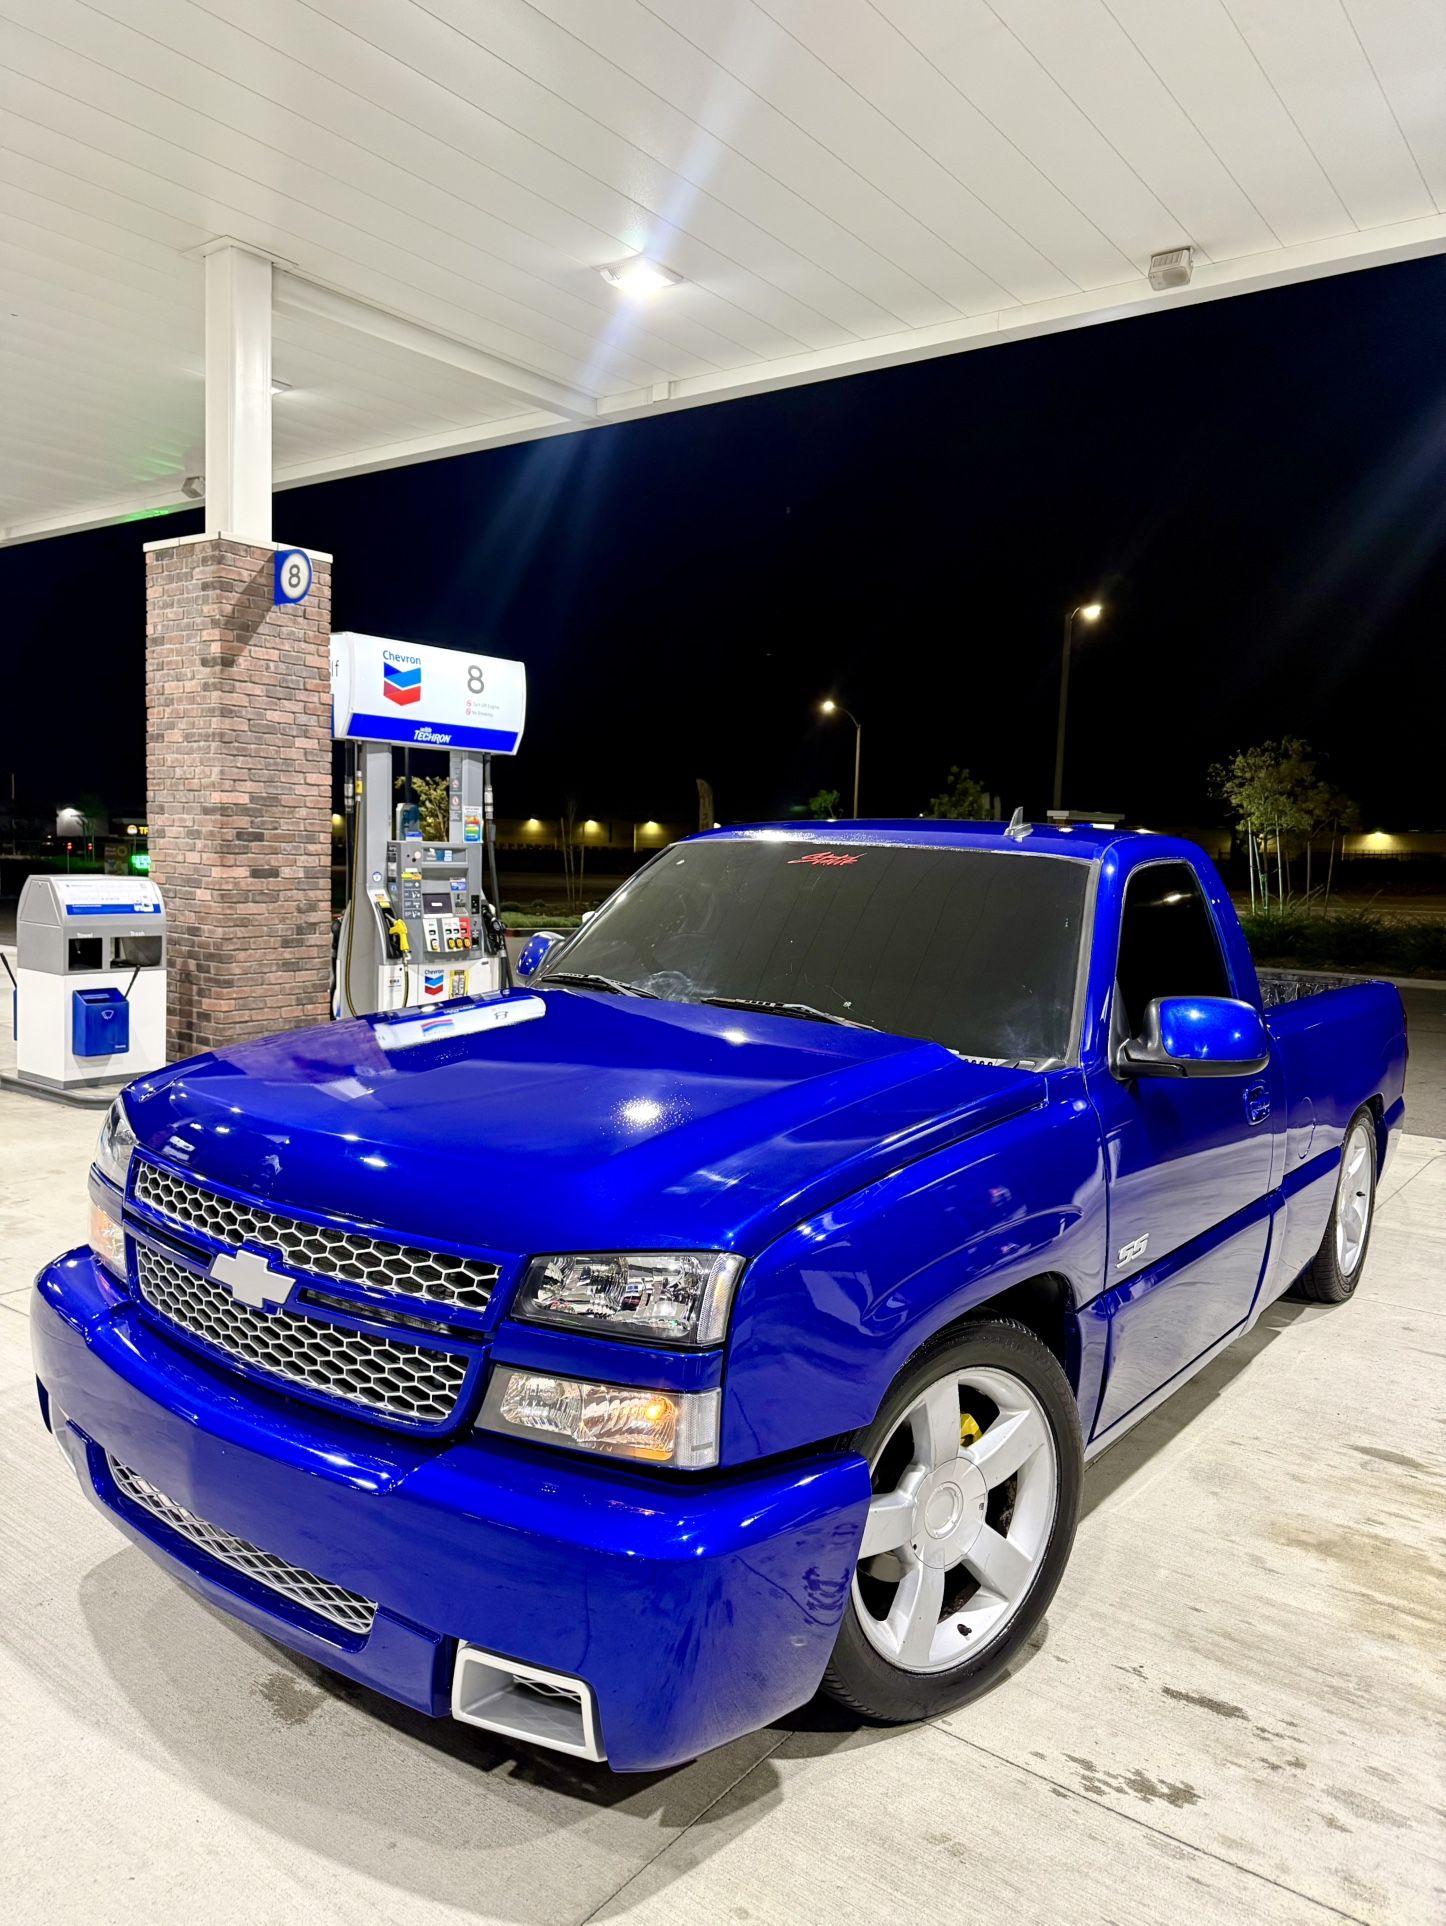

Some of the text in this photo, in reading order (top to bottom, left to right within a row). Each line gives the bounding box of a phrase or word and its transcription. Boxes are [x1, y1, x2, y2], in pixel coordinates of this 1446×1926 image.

[288, 564, 301, 589] 8
[382, 649, 422, 665] Chevron
[467, 664, 485, 694] 8
[413, 729, 452, 744] TECHRON
[1115, 1232, 1150, 1269] SS
